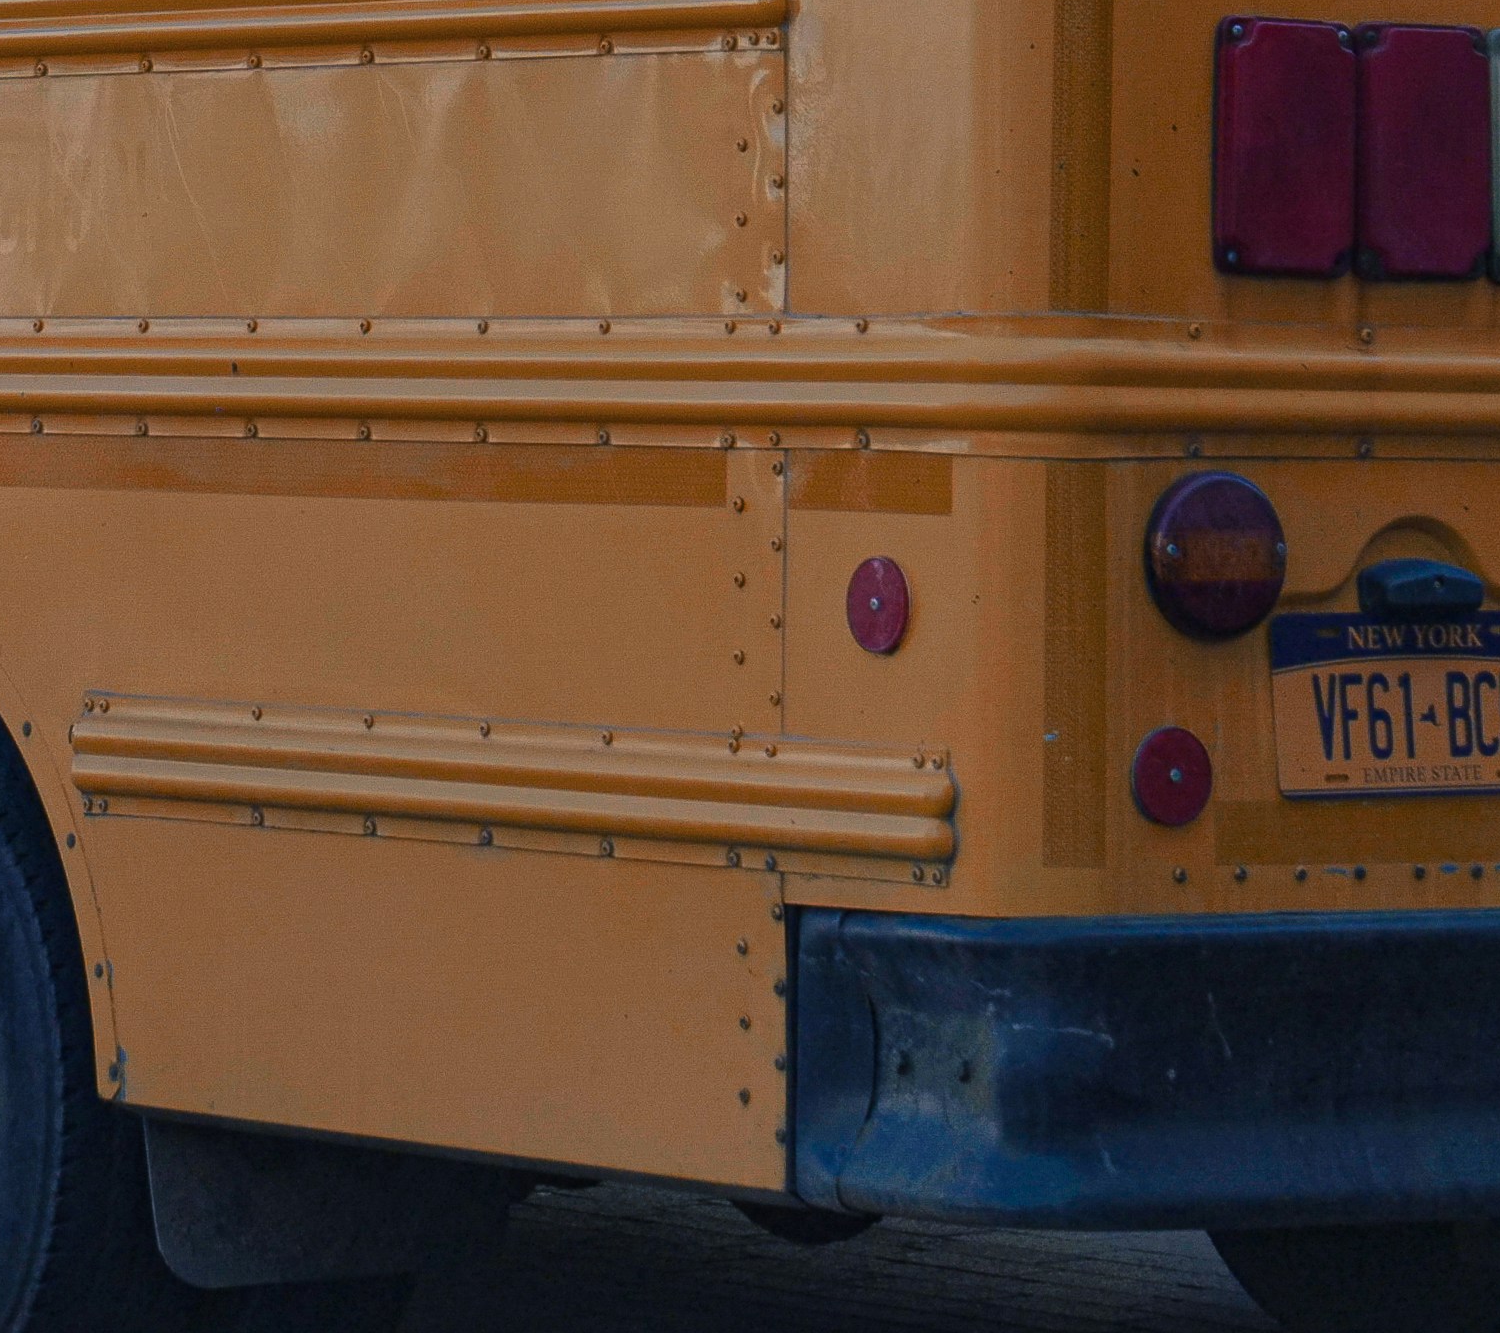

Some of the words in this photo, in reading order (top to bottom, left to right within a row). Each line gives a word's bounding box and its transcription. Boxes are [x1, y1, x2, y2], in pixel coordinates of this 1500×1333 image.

[1346, 624, 1404, 650] NEW
[1412, 622, 1486, 650] YORK
[1362, 764, 1428, 786] EMPIRE
[1431, 762, 1486, 783] STATE
